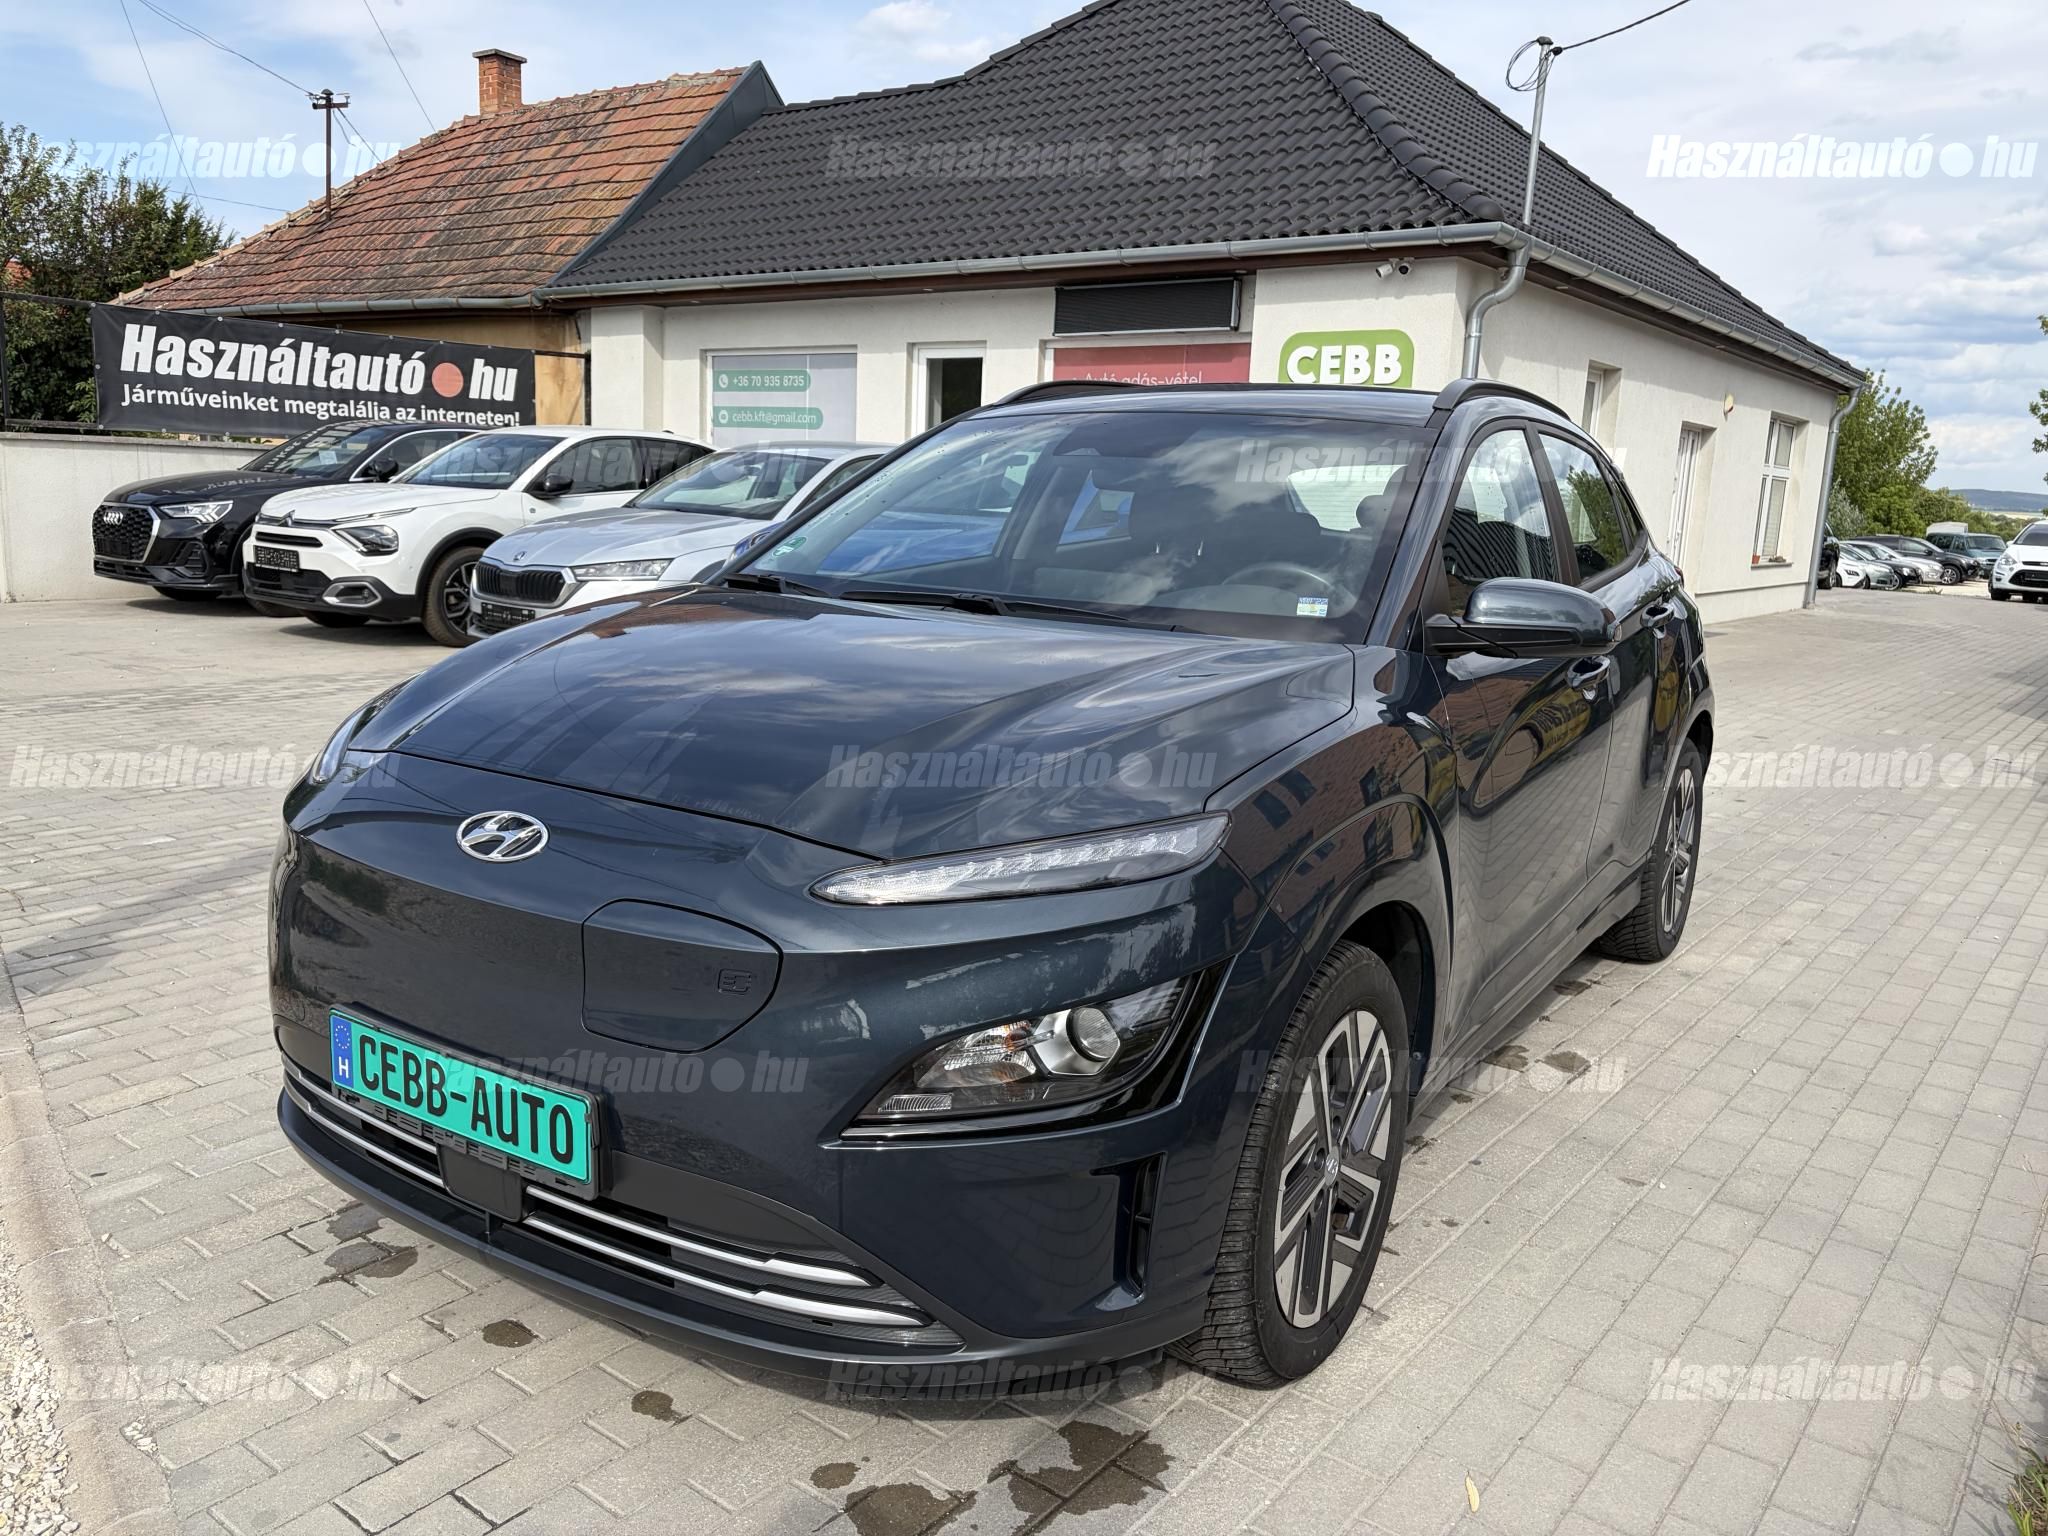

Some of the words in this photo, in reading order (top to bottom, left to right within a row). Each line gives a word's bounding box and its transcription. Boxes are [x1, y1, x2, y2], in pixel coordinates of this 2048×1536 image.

[120, 323, 426, 395] Használtautó
[468, 358, 518, 402] hu
[732, 375, 749, 387] +36
[751, 375, 762, 387] 70
[764, 375, 780, 387] 935
[783, 375, 805, 387] 8735
[1286, 343, 1402, 385] CEBB
[121, 383, 280, 413] Járműveinket
[284, 397, 390, 420] megtalálja
[395, 407, 417, 421] az
[420, 404, 520, 427] interneten!
[732, 410, 817, 426] cebb.kft@gmail.com
[338, 1056, 349, 1079] H
[358, 1034, 574, 1164] CEBB-AUTO
